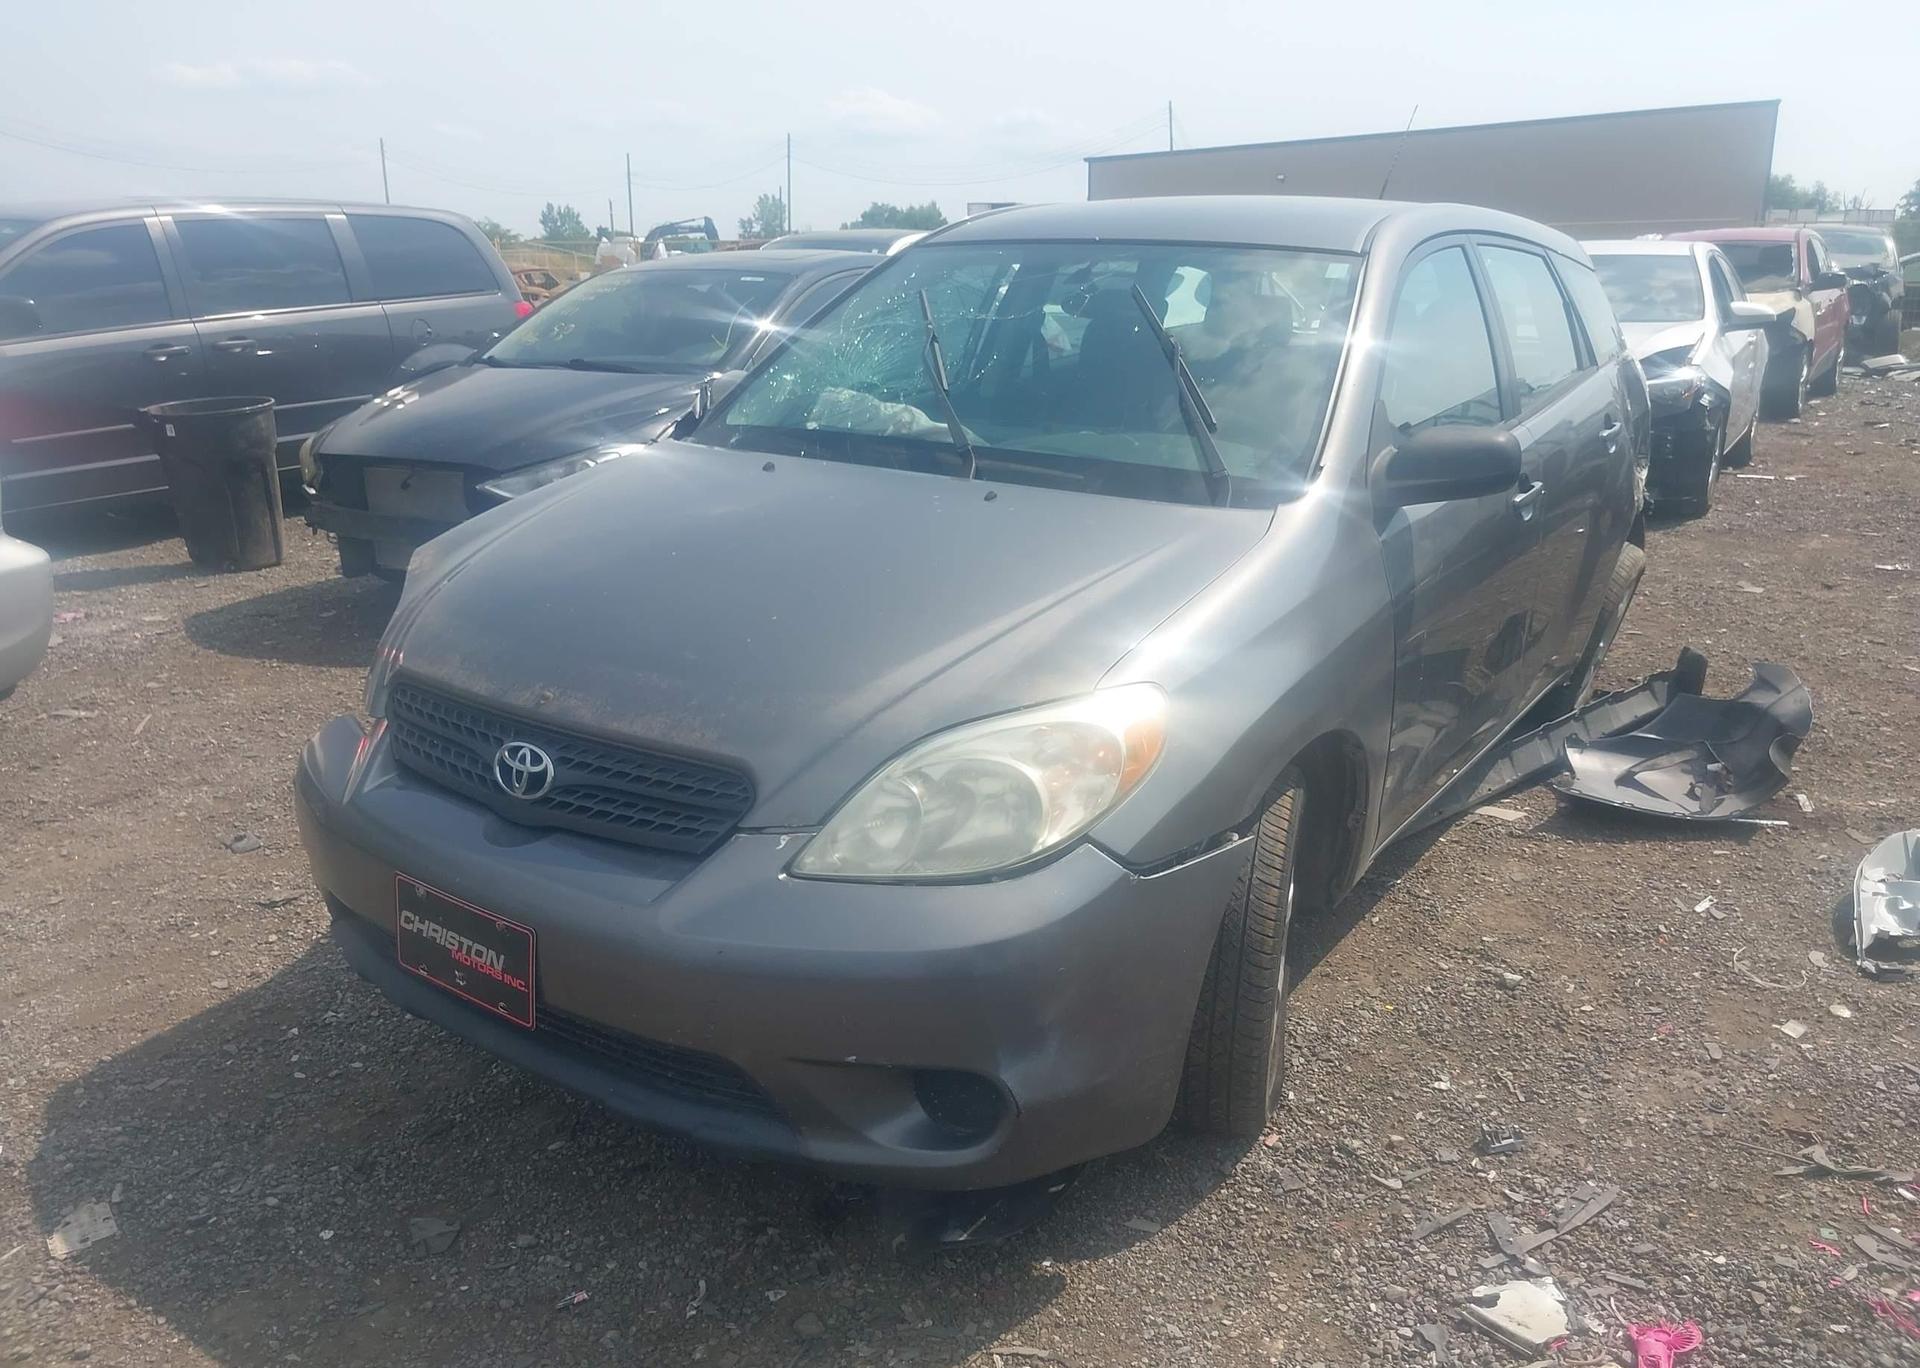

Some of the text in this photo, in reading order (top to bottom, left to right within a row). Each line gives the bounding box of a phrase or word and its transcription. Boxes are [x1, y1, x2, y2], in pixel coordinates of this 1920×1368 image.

[400, 910, 505, 970] CHRISTON
[450, 949, 529, 993] MOTORS INC.
